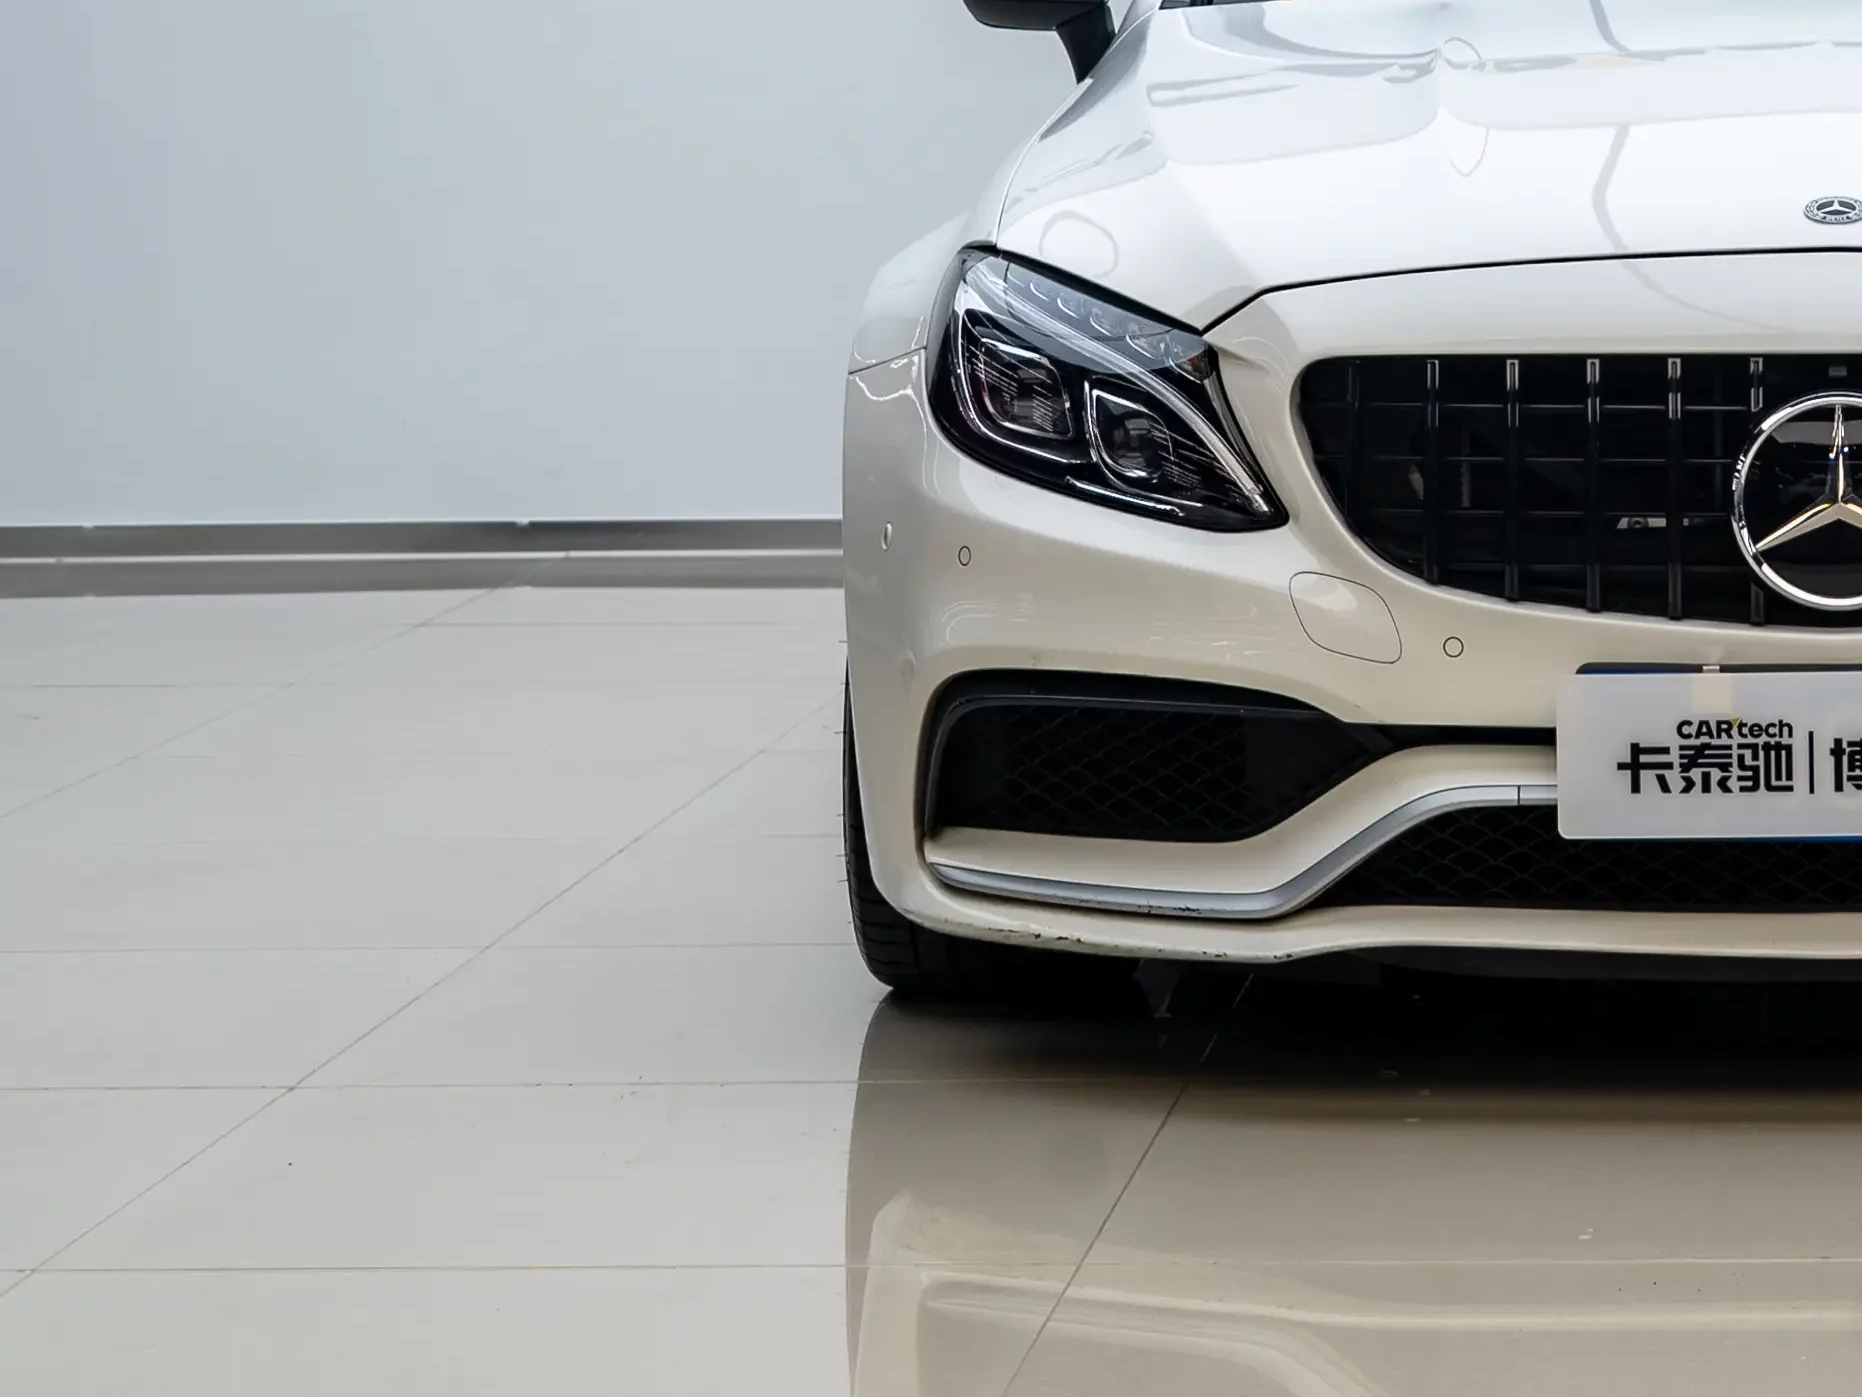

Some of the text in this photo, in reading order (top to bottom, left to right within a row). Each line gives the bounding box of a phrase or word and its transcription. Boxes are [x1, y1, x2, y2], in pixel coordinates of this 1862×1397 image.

[1676, 717, 1794, 739] CARtech
[1617, 741, 1794, 794] 卡泰驰
